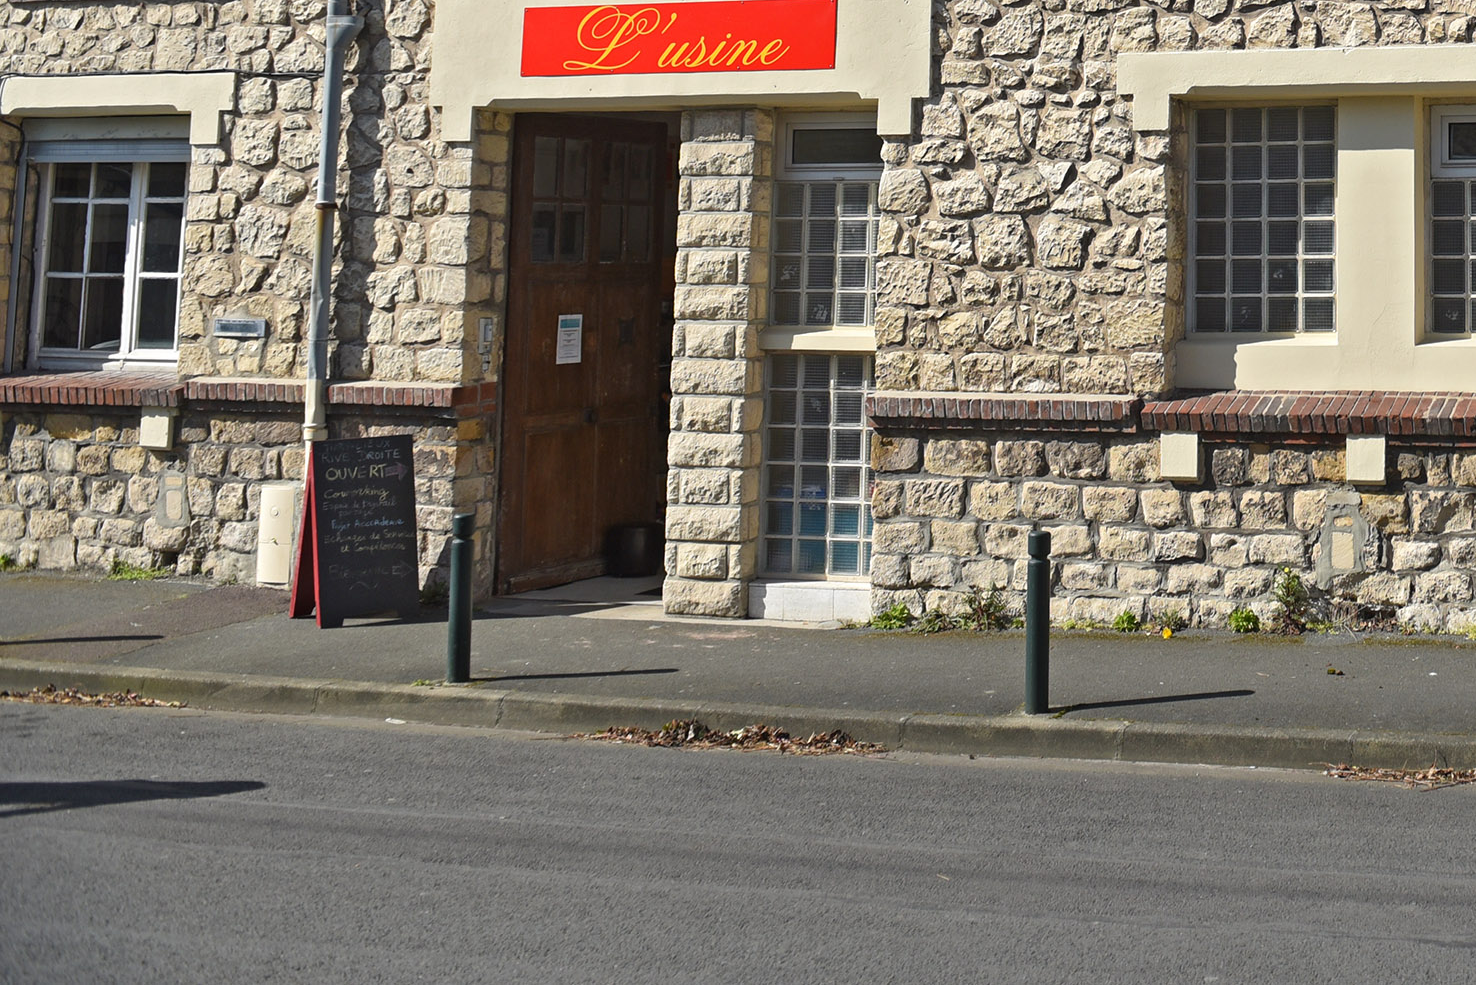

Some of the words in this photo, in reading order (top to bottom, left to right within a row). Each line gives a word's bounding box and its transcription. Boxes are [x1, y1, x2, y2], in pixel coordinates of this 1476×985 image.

[563, 5, 790, 71] L'usine
[321, 452, 352, 463] RIVE
[358, 448, 401, 462] DROITE
[325, 463, 387, 481] OUVERT
